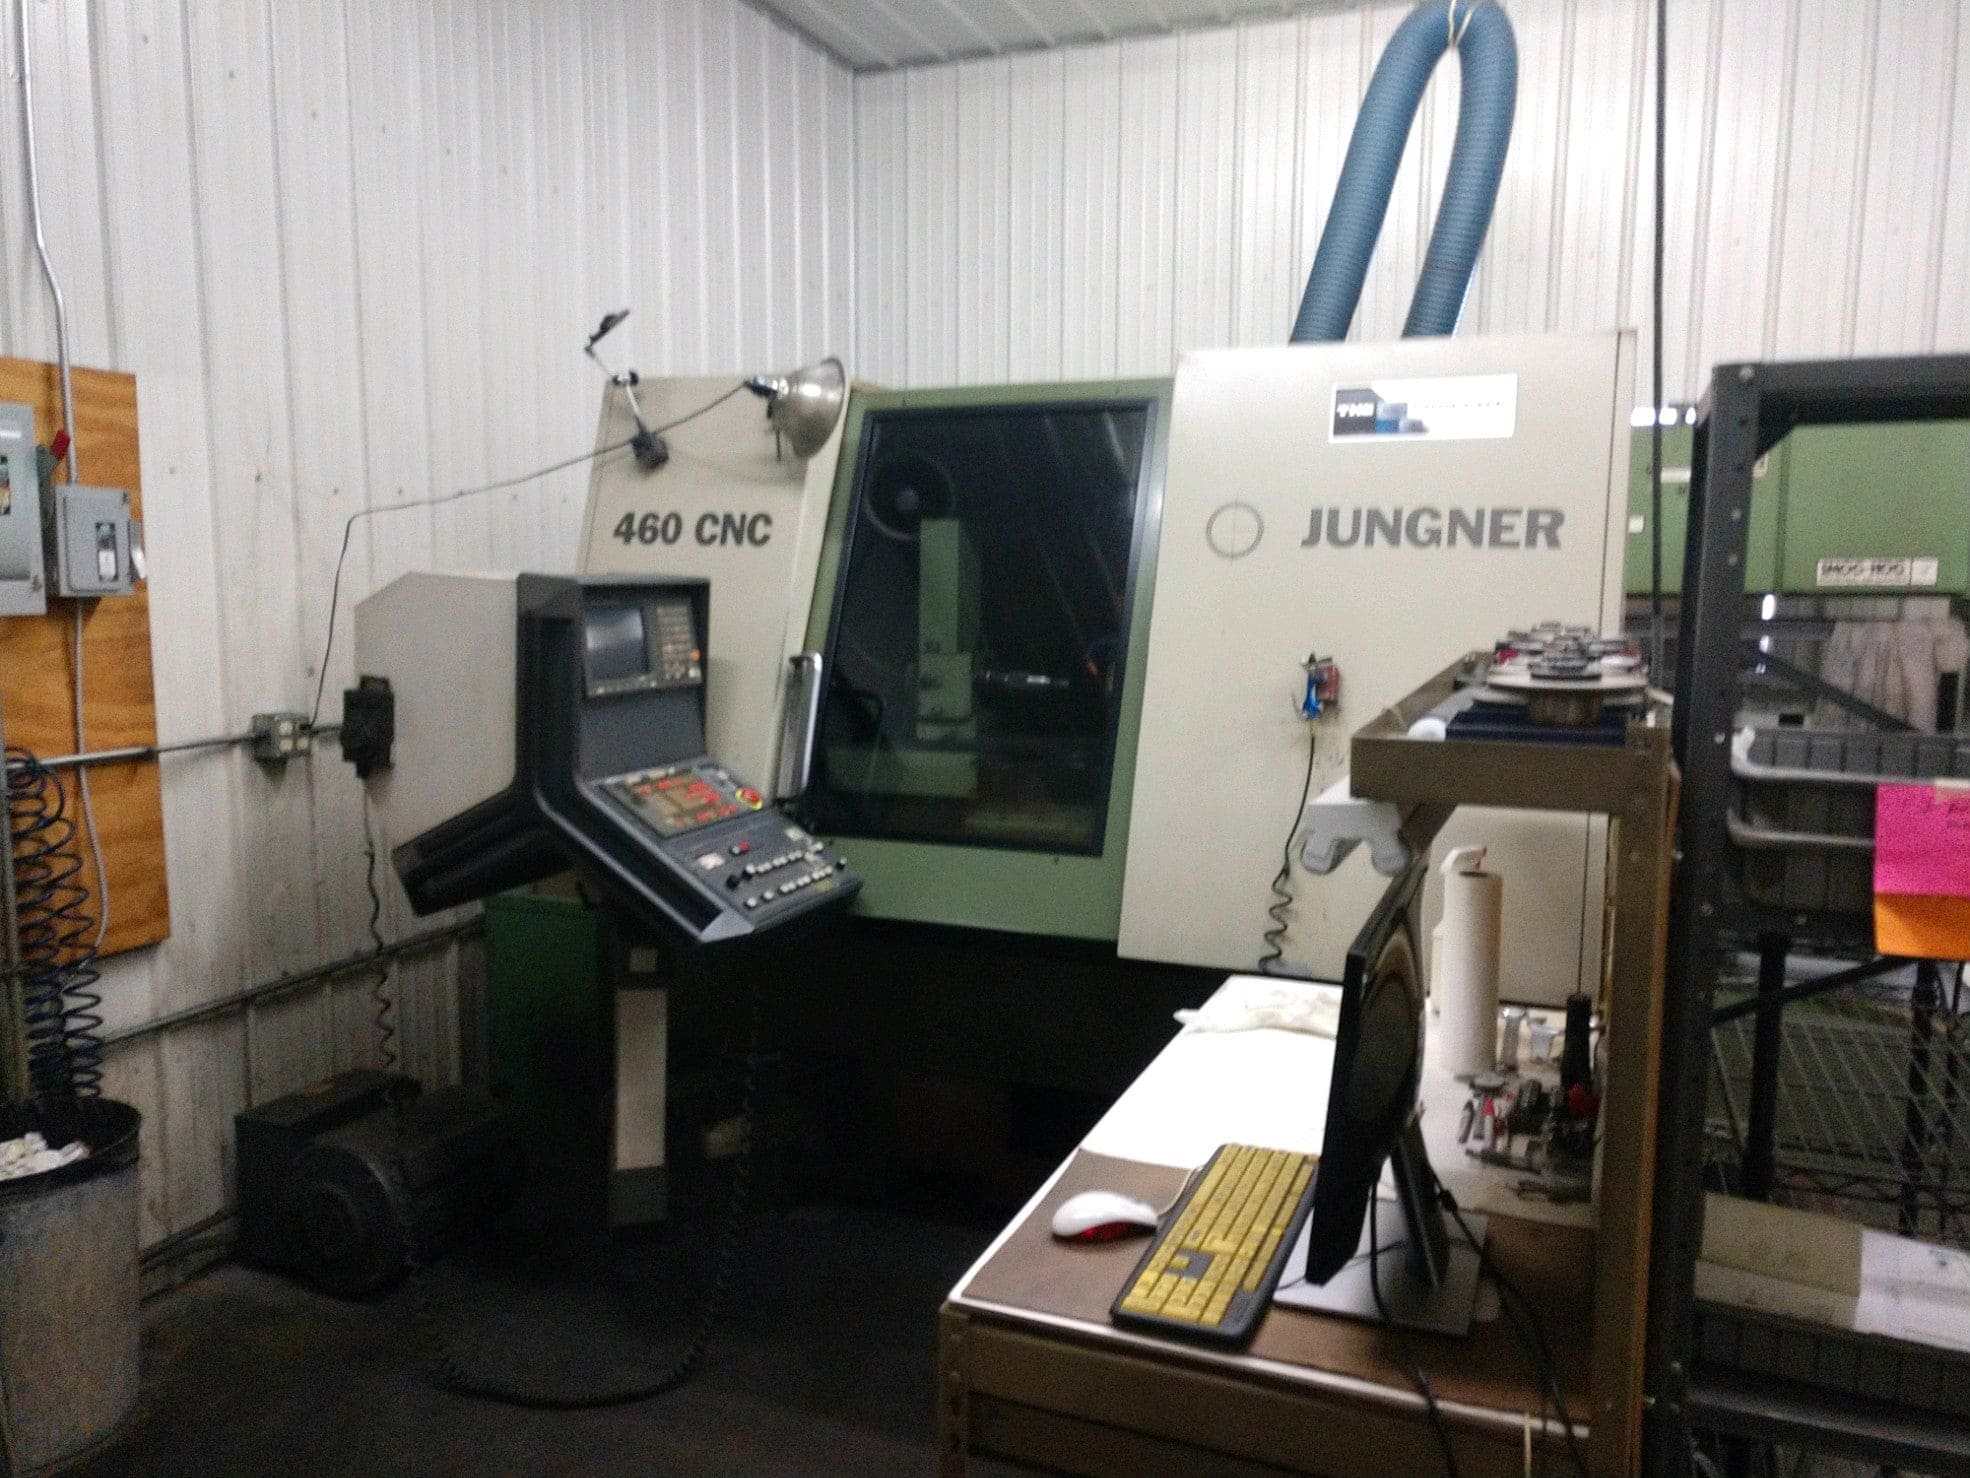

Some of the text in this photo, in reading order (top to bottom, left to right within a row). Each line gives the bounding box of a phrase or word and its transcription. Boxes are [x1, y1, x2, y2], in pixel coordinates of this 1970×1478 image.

[613, 511, 773, 547] 460 CNC
[1300, 506, 1565, 549] JUNGNER
